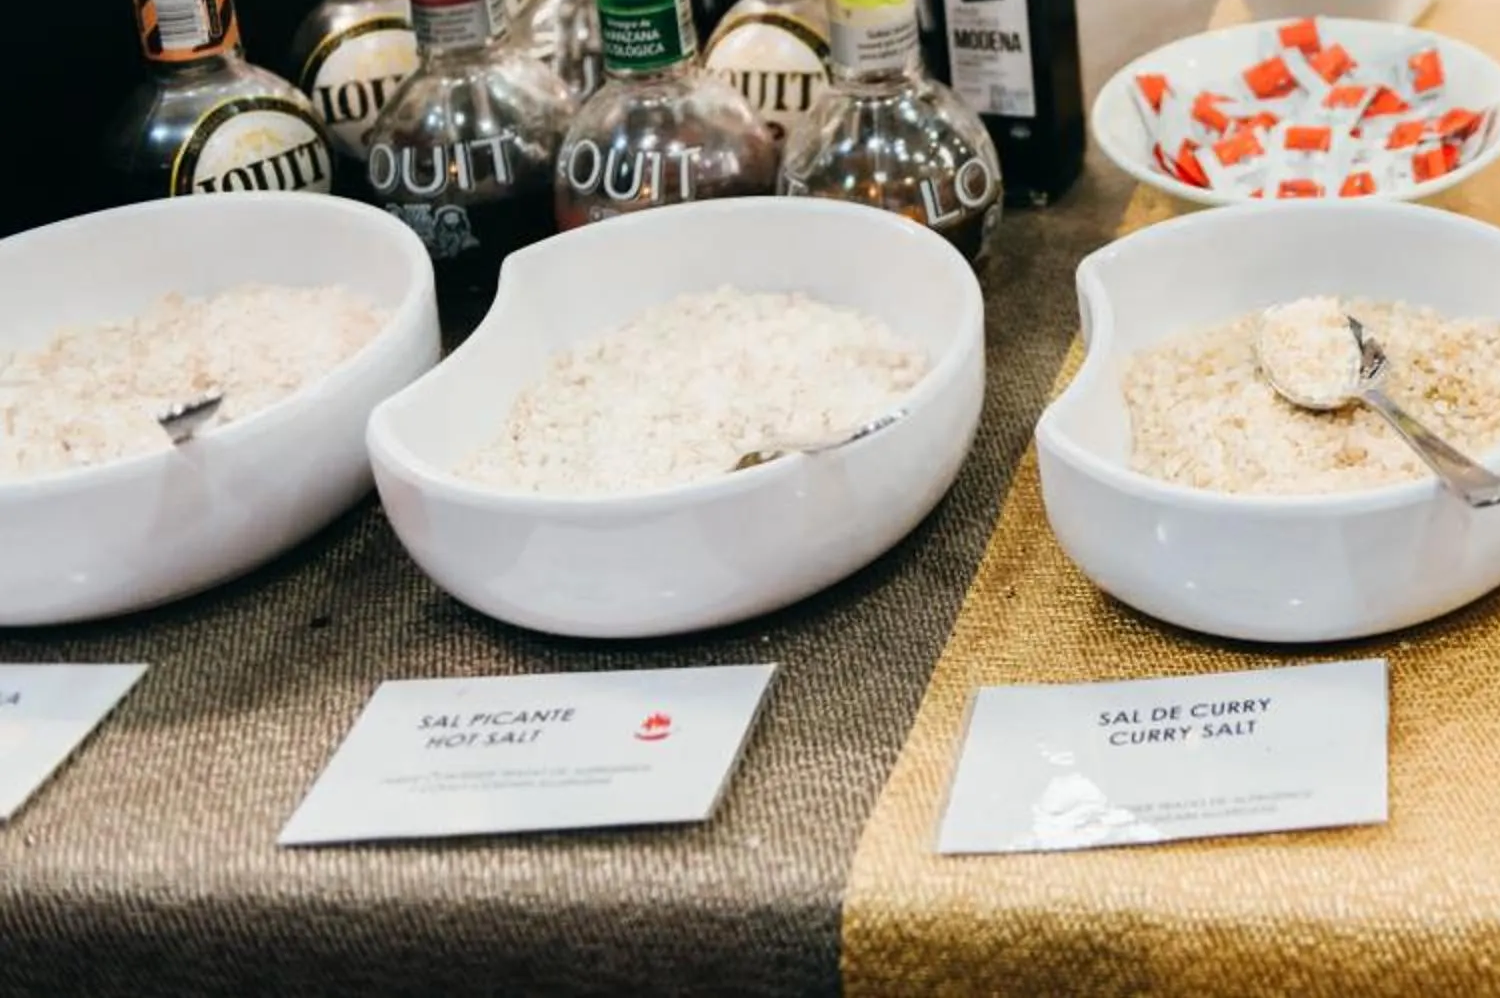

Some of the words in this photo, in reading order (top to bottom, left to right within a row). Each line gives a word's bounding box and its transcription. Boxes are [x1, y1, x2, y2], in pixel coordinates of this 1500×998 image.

[953, 28, 1022, 52] MODENA
[418, 714, 460, 730] SAL
[467, 708, 576, 727] PICANTE
[1098, 710, 1142, 726] SAL
[1151, 706, 1182, 722] DE
[1189, 698, 1272, 717] CURRY
[425, 732, 480, 749] HOT
[484, 729, 543, 745] SALT
[1109, 725, 1192, 746] CURRY
[1202, 719, 1258, 738] SALT
